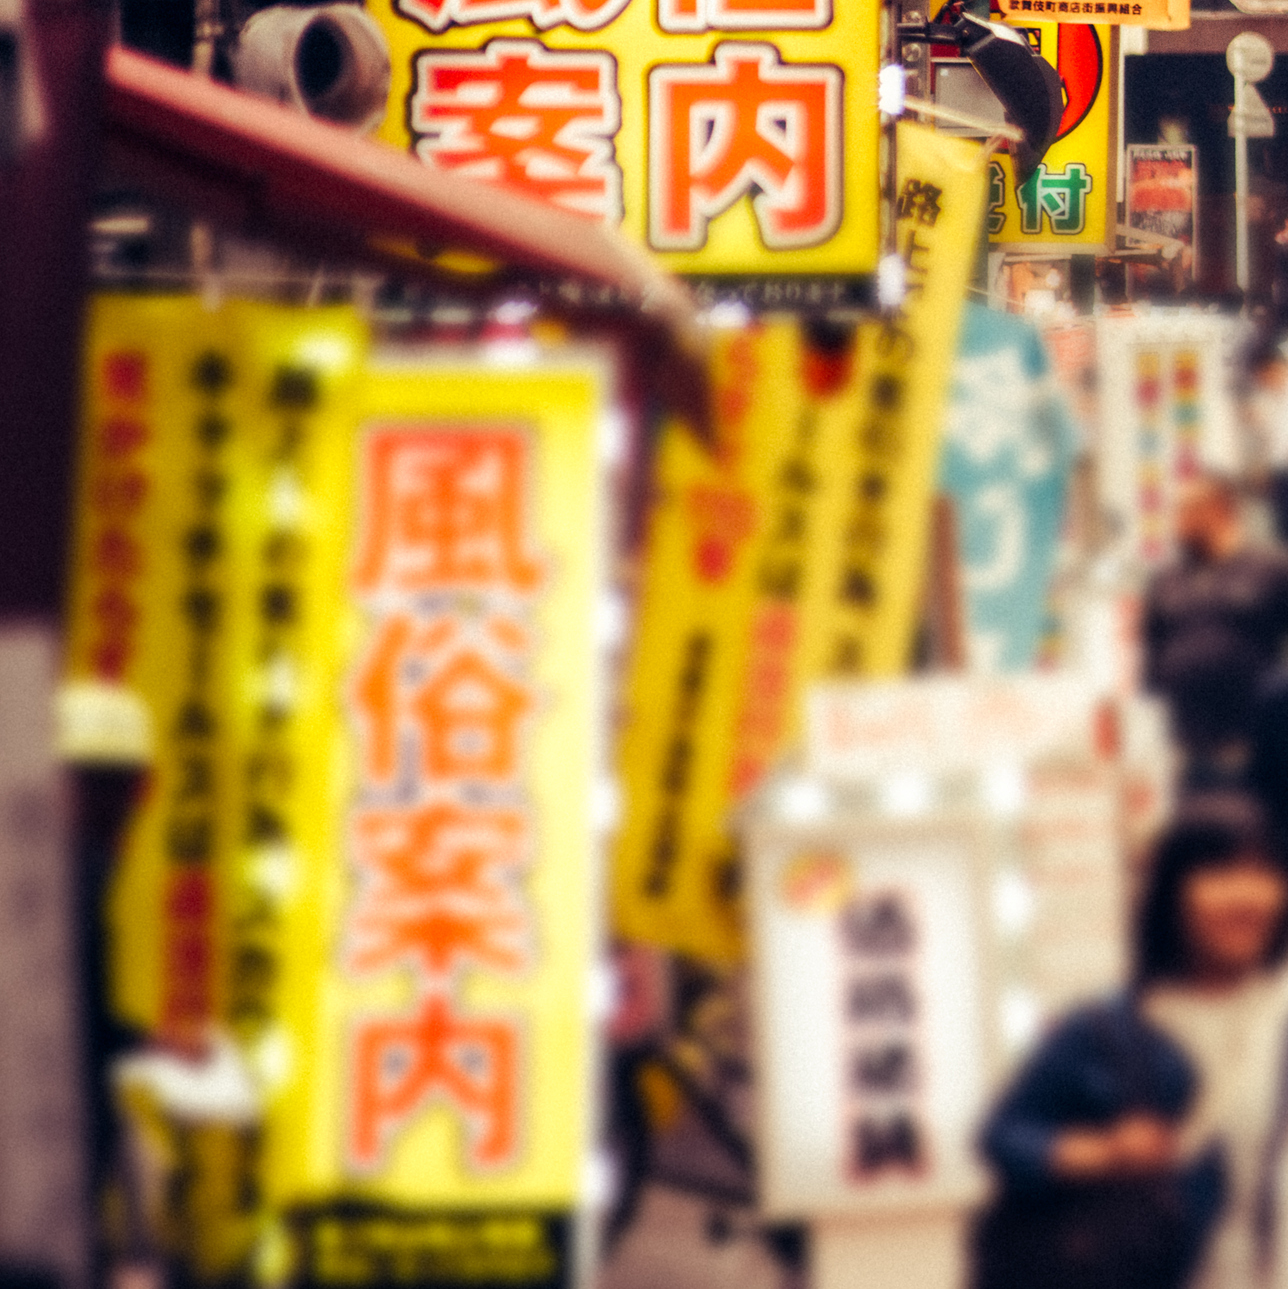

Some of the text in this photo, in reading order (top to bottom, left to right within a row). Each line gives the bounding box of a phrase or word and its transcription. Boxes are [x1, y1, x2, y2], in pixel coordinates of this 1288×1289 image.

[409, 39, 846, 251] 案内
[988, 162, 1093, 236] 付
[350, 422, 540, 1175] 風俗案内
